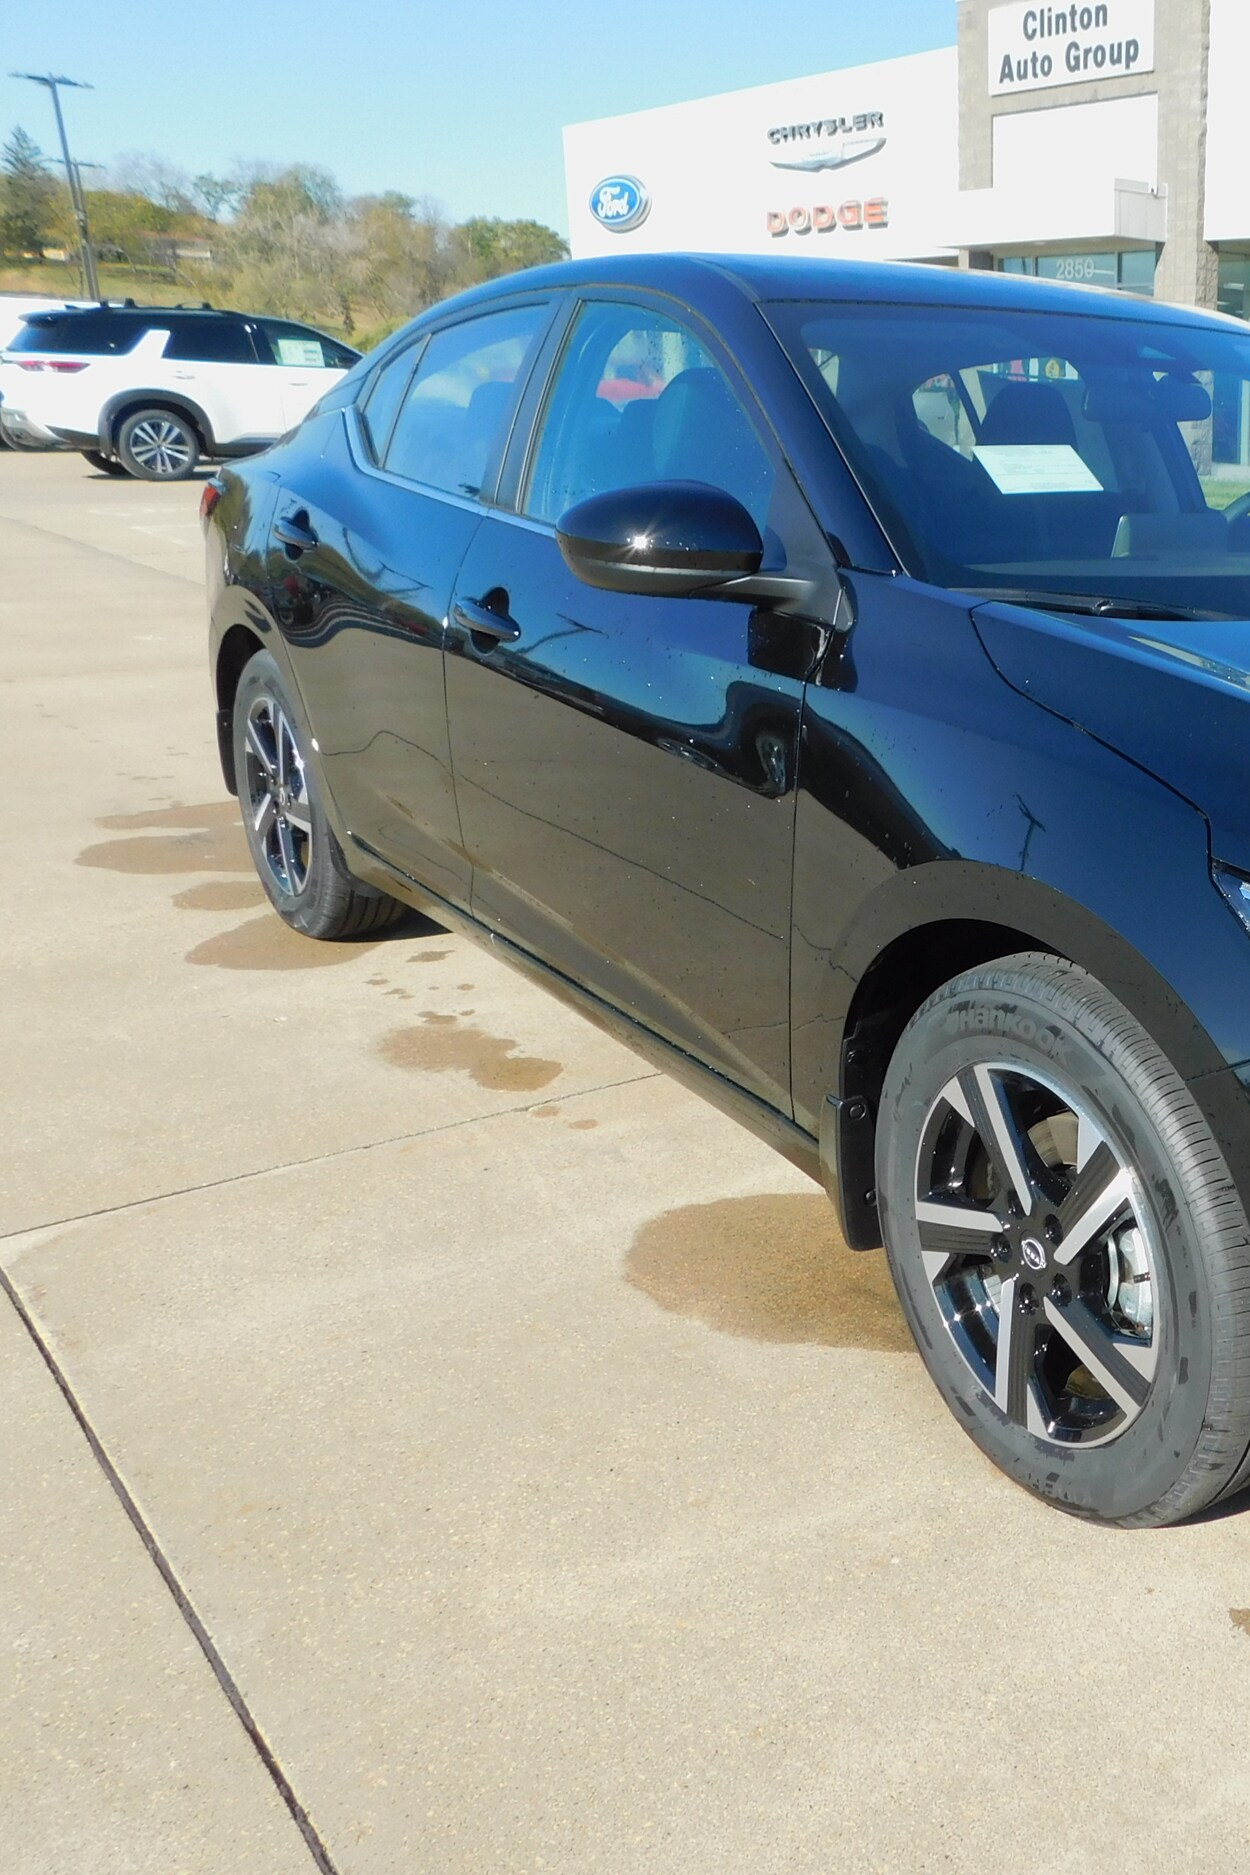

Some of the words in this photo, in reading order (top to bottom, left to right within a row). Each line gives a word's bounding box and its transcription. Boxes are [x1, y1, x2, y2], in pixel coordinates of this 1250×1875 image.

[1022, 4, 1108, 41] Clinton
[998, 52, 1052, 84] Auto
[1065, 38, 1139, 73] Group
[767, 111, 884, 145] CHRYSLER
[597, 186, 630, 218] Ford
[767, 197, 887, 236] DODGE
[1055, 258, 1095, 279] 2850
